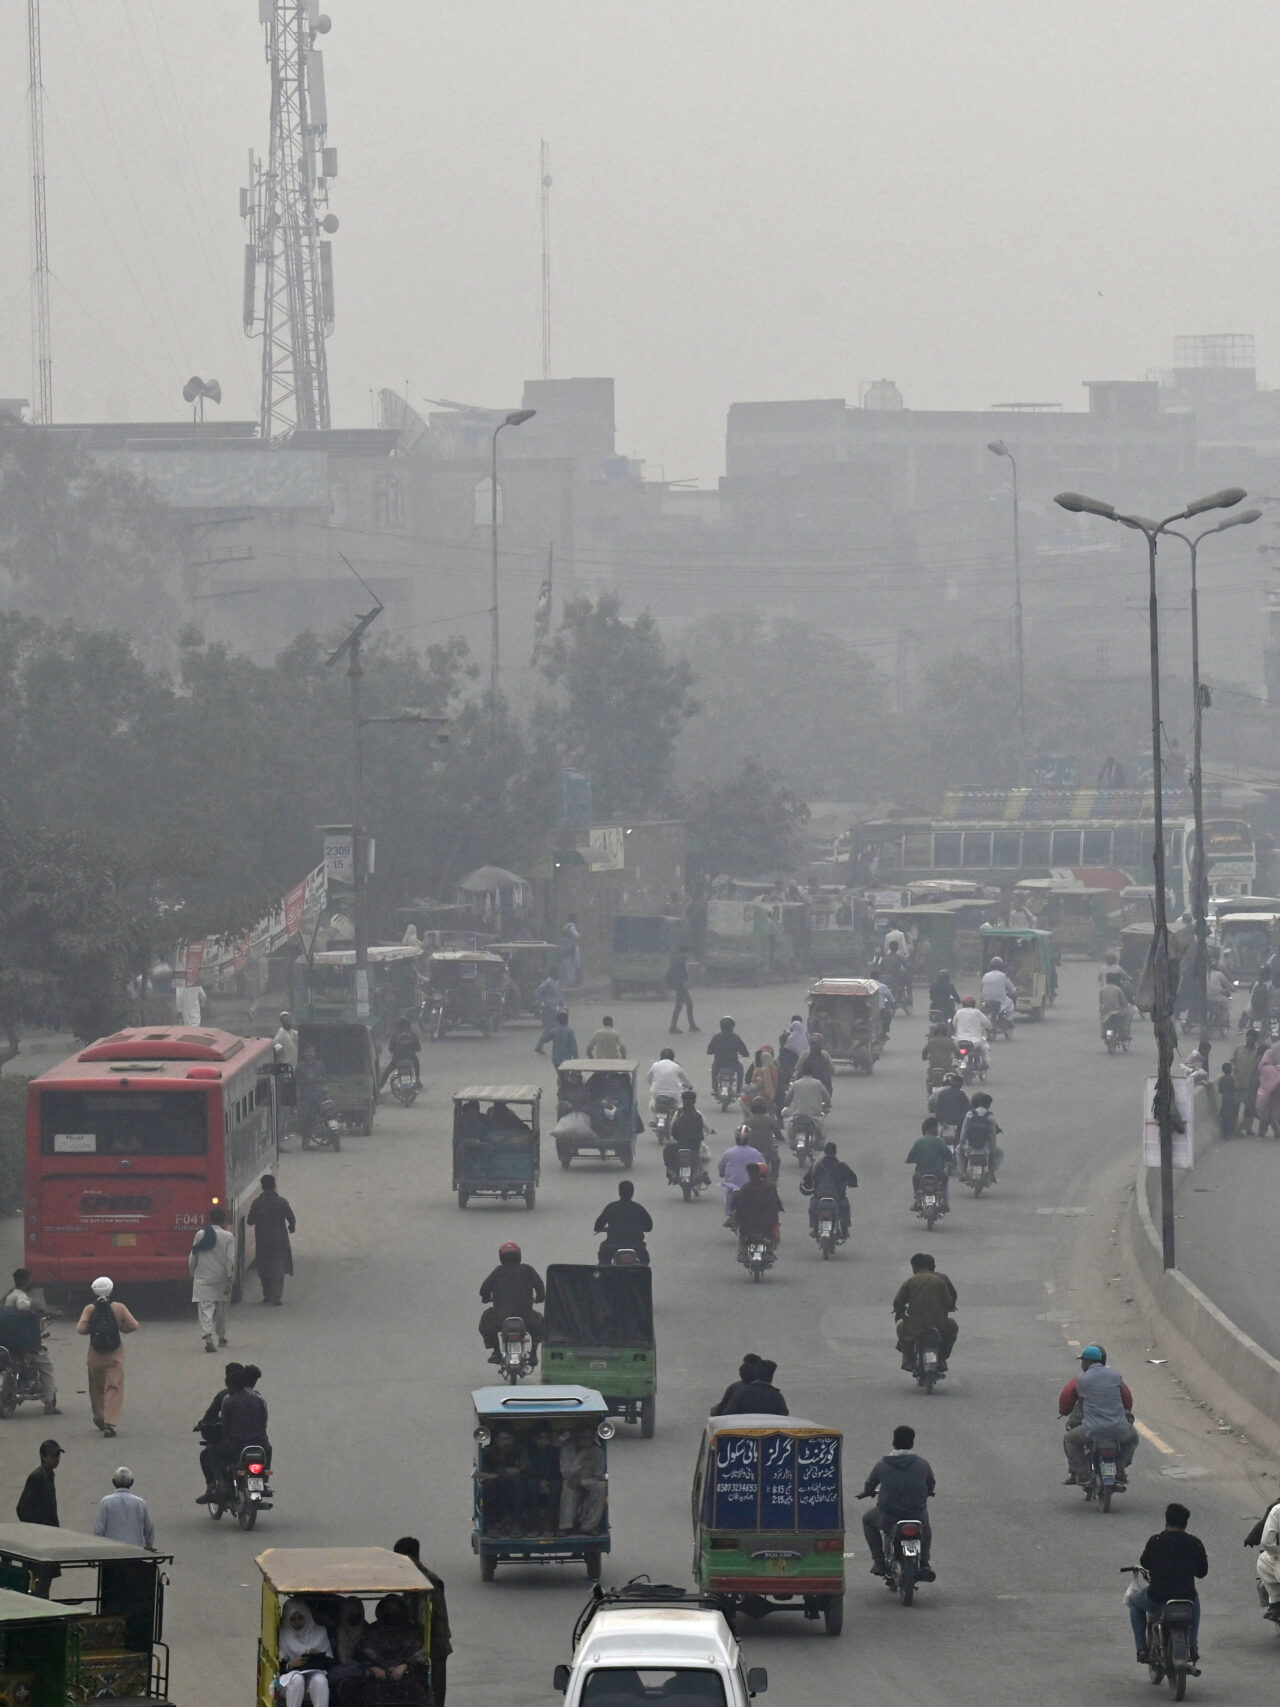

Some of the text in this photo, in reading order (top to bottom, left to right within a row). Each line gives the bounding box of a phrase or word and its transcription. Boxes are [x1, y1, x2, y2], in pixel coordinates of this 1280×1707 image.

[326, 846, 350, 856] 2309
[333, 860, 344, 869] 15
[174, 1213, 205, 1225] F041
[765, 1437, 794, 1467] گرلز
[797, 1440, 838, 1465] گورنمنٹ
